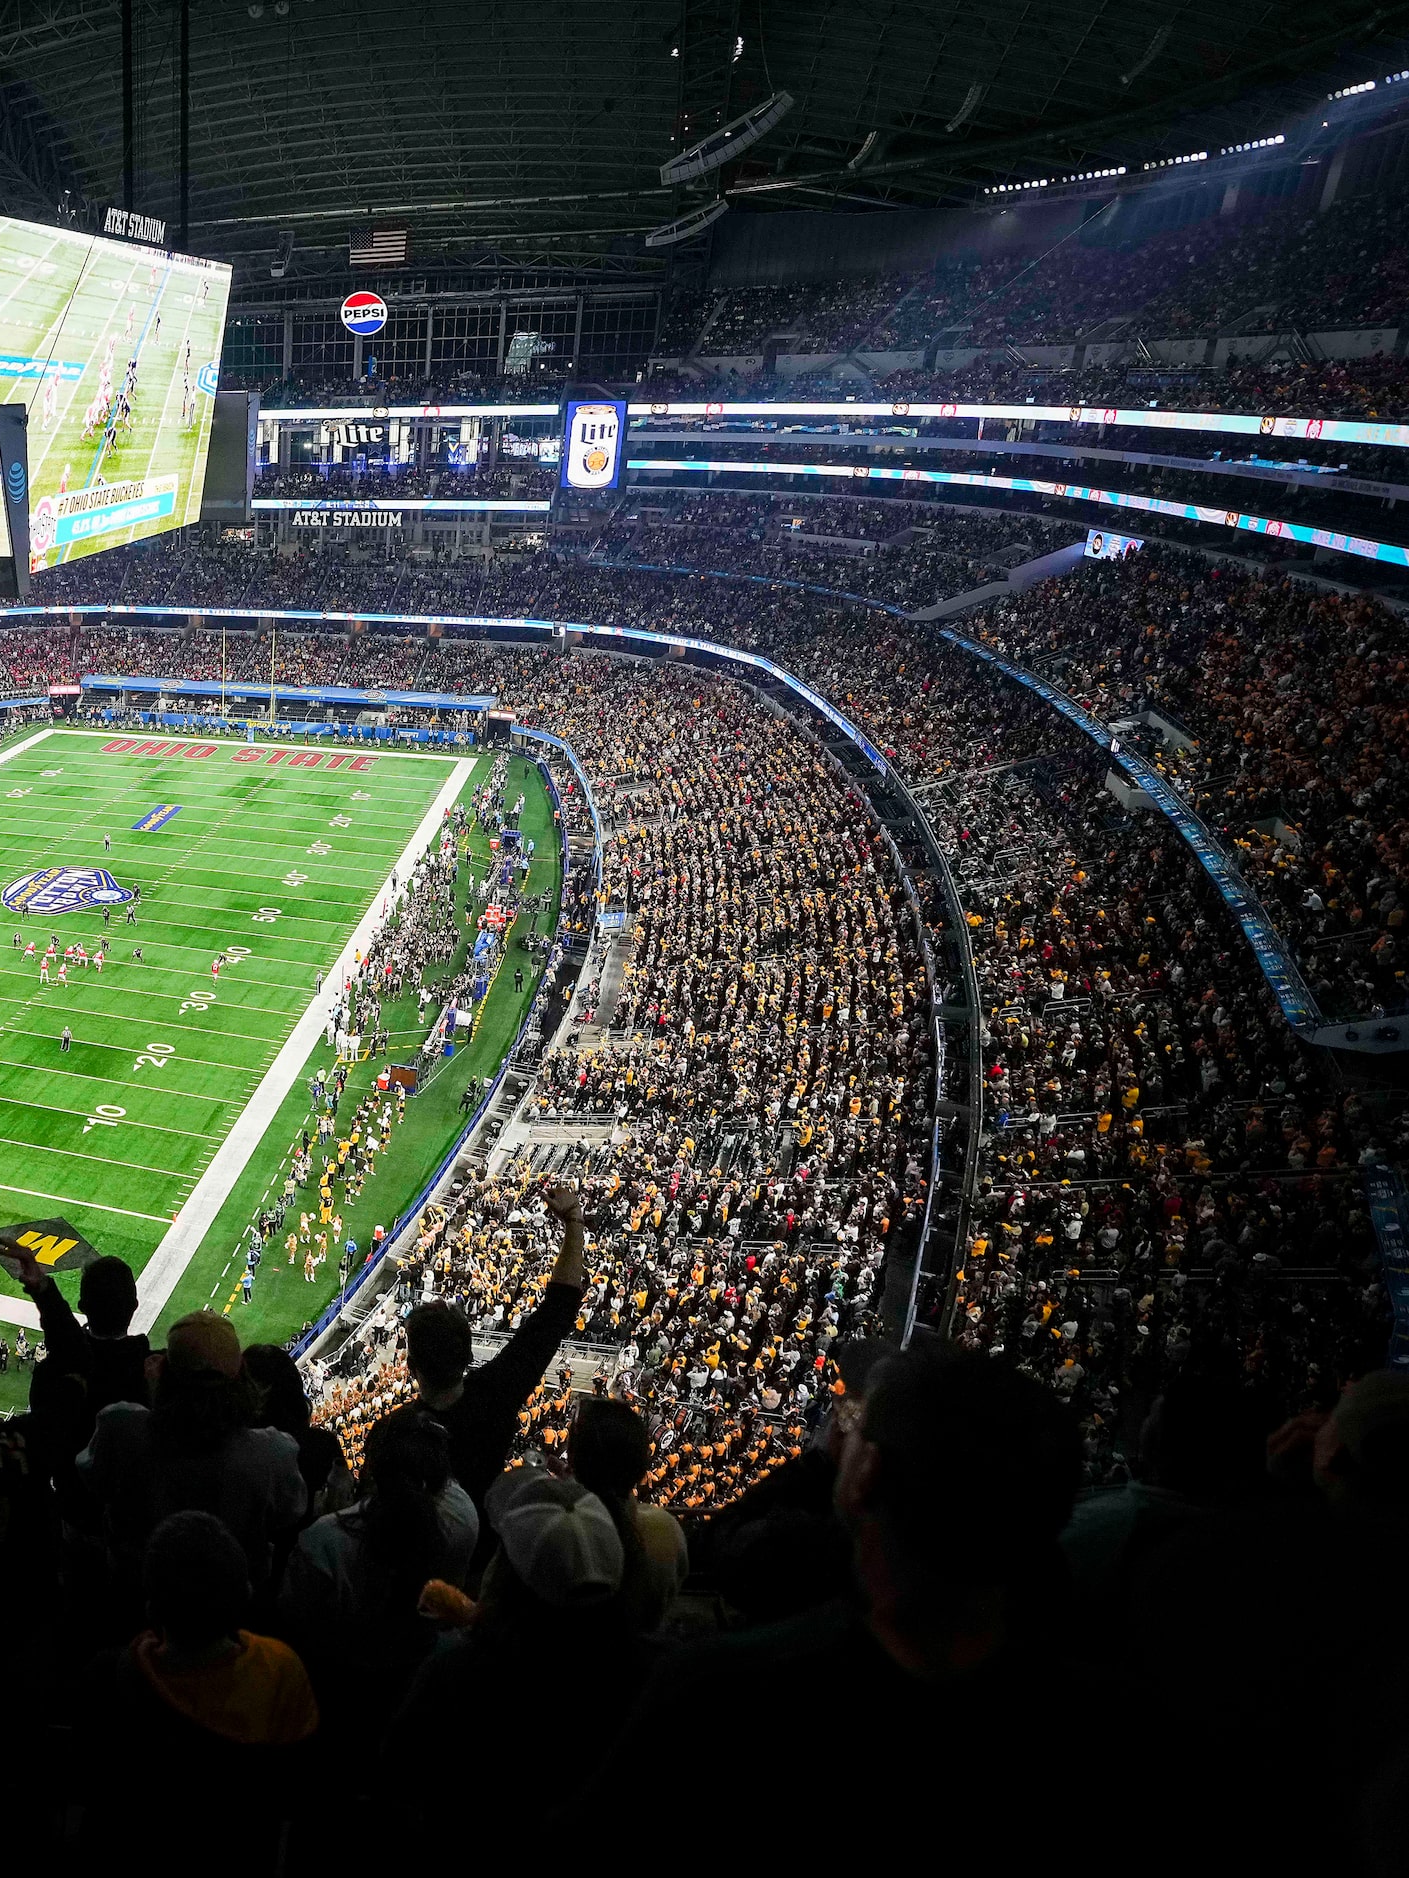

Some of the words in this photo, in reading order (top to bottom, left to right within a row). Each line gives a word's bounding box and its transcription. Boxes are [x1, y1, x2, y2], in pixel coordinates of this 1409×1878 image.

[103, 207, 129, 236] AT&T
[128, 213, 166, 244] STADIUM
[344, 308, 385, 319] PEPSI
[337, 421, 384, 448] Lite
[580, 423, 616, 445] Lite
[58, 498, 70, 516] #7
[69, 493, 88, 514] OHIO
[88, 488, 110, 509] STATE
[110, 482, 145, 504] BUCKEYES
[292, 511, 331, 526] AT&T
[332, 511, 403, 527] STADIUM
[100, 738, 219, 759] OHIO
[231, 747, 382, 772] STATE
[328, 815, 353, 828] 20
[306, 842, 333, 856] 30
[6, 867, 63, 907] GOODYEAR
[281, 872, 309, 887] 40
[252, 907, 282, 923] 50
[181, 991, 217, 1012] 30
[136, 1043, 176, 1068] 20
[86, 1104, 127, 1127] 10
